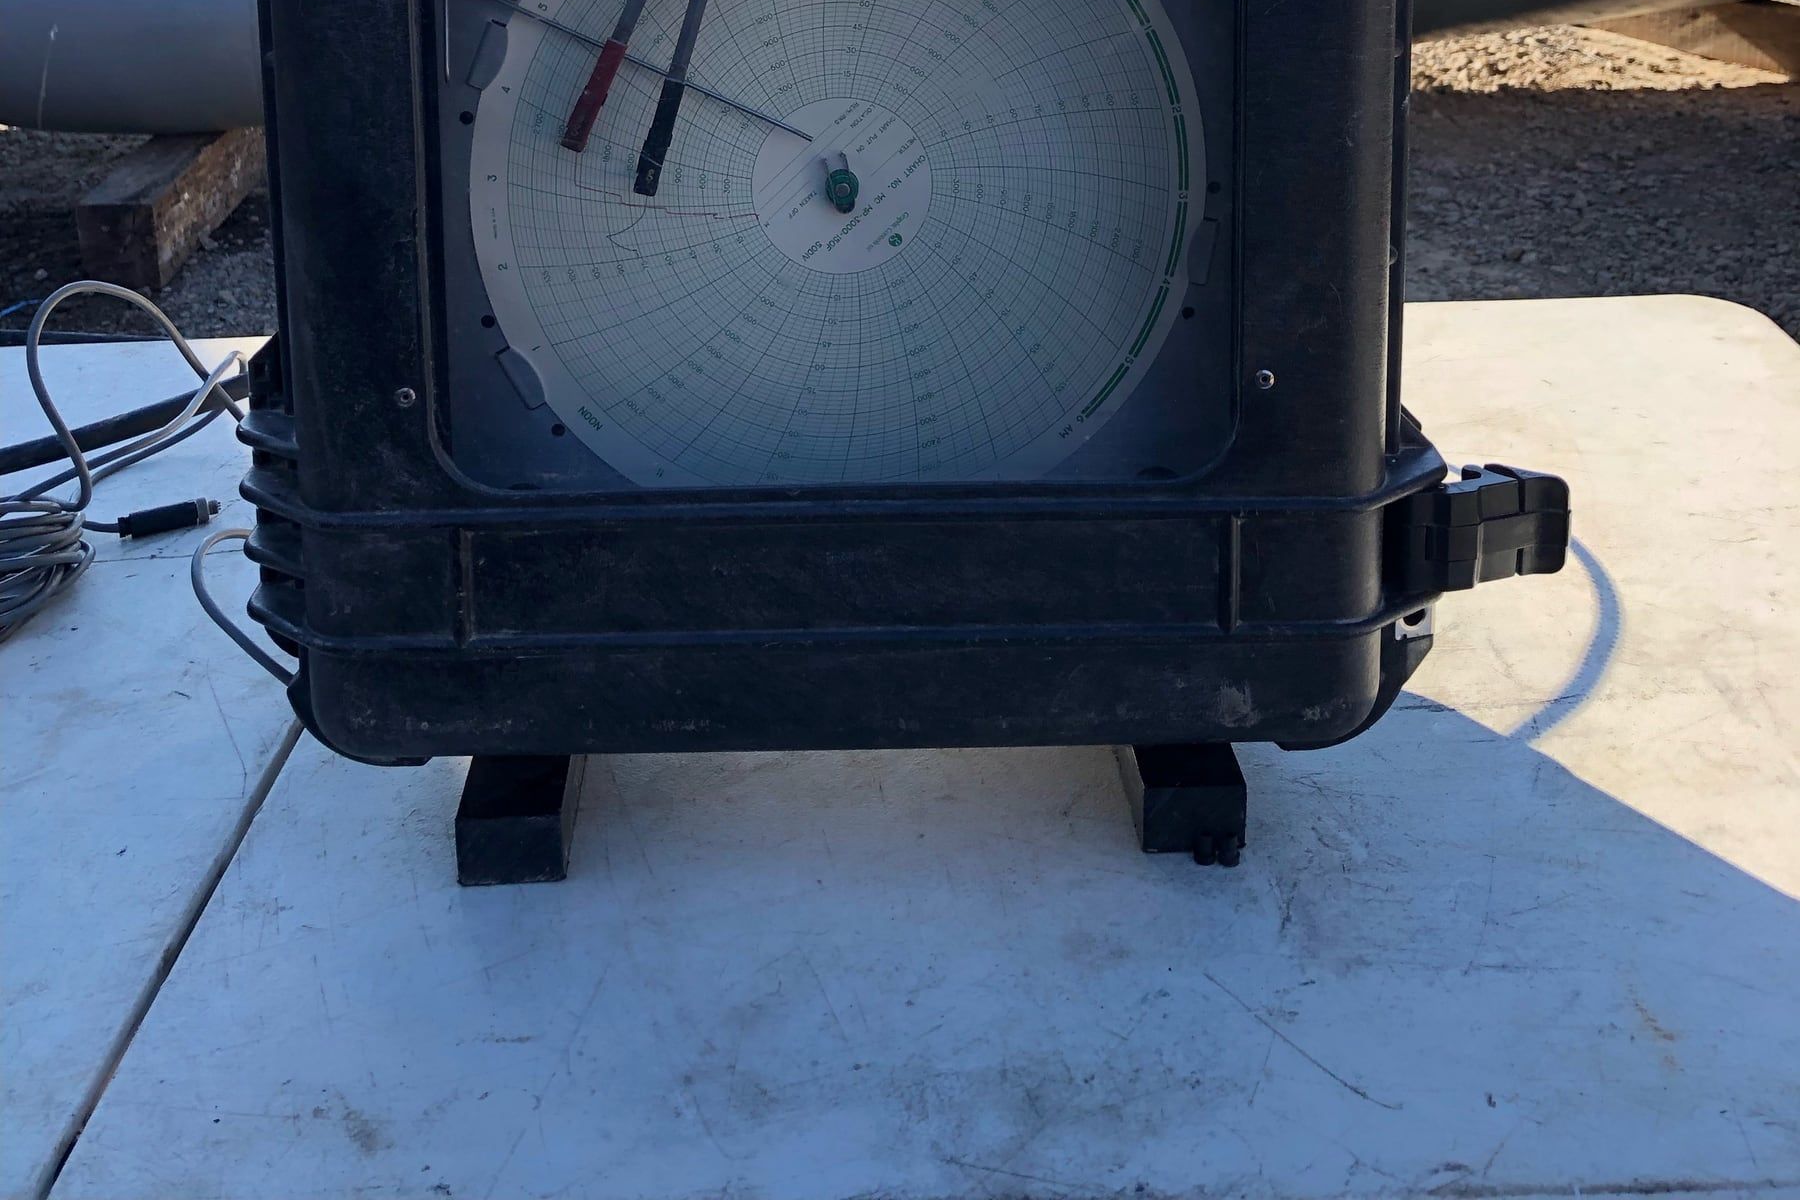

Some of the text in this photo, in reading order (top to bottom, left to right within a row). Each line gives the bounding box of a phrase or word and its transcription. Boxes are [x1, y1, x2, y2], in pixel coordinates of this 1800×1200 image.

[537, 2, 548, 12] 5
[756, 13, 774, 25] 1200
[653, 33, 665, 45] 90
[763, 36, 779, 48] 900
[770, 60, 786, 72] 600
[501, 85, 511, 94] 4
[777, 83, 793, 95] 300
[1171, 105, 1182, 113] 2
[898, 136, 917, 155] METER
[903, 154, 927, 178] CHART
[487, 174, 498, 182] 3
[674, 167, 683, 184] 900
[698, 172, 708, 190] 600
[723, 178, 731, 195] 300
[887, 177, 903, 190] NO.
[874, 192, 887, 205] MC
[1179, 191, 1189, 200] 3
[497, 261, 508, 272] 2
[1161, 277, 1172, 287] 4
[1124, 356, 1135, 366] 5
[577, 405, 604, 432] NOON
[1058, 414, 1085, 440] 6 AM
